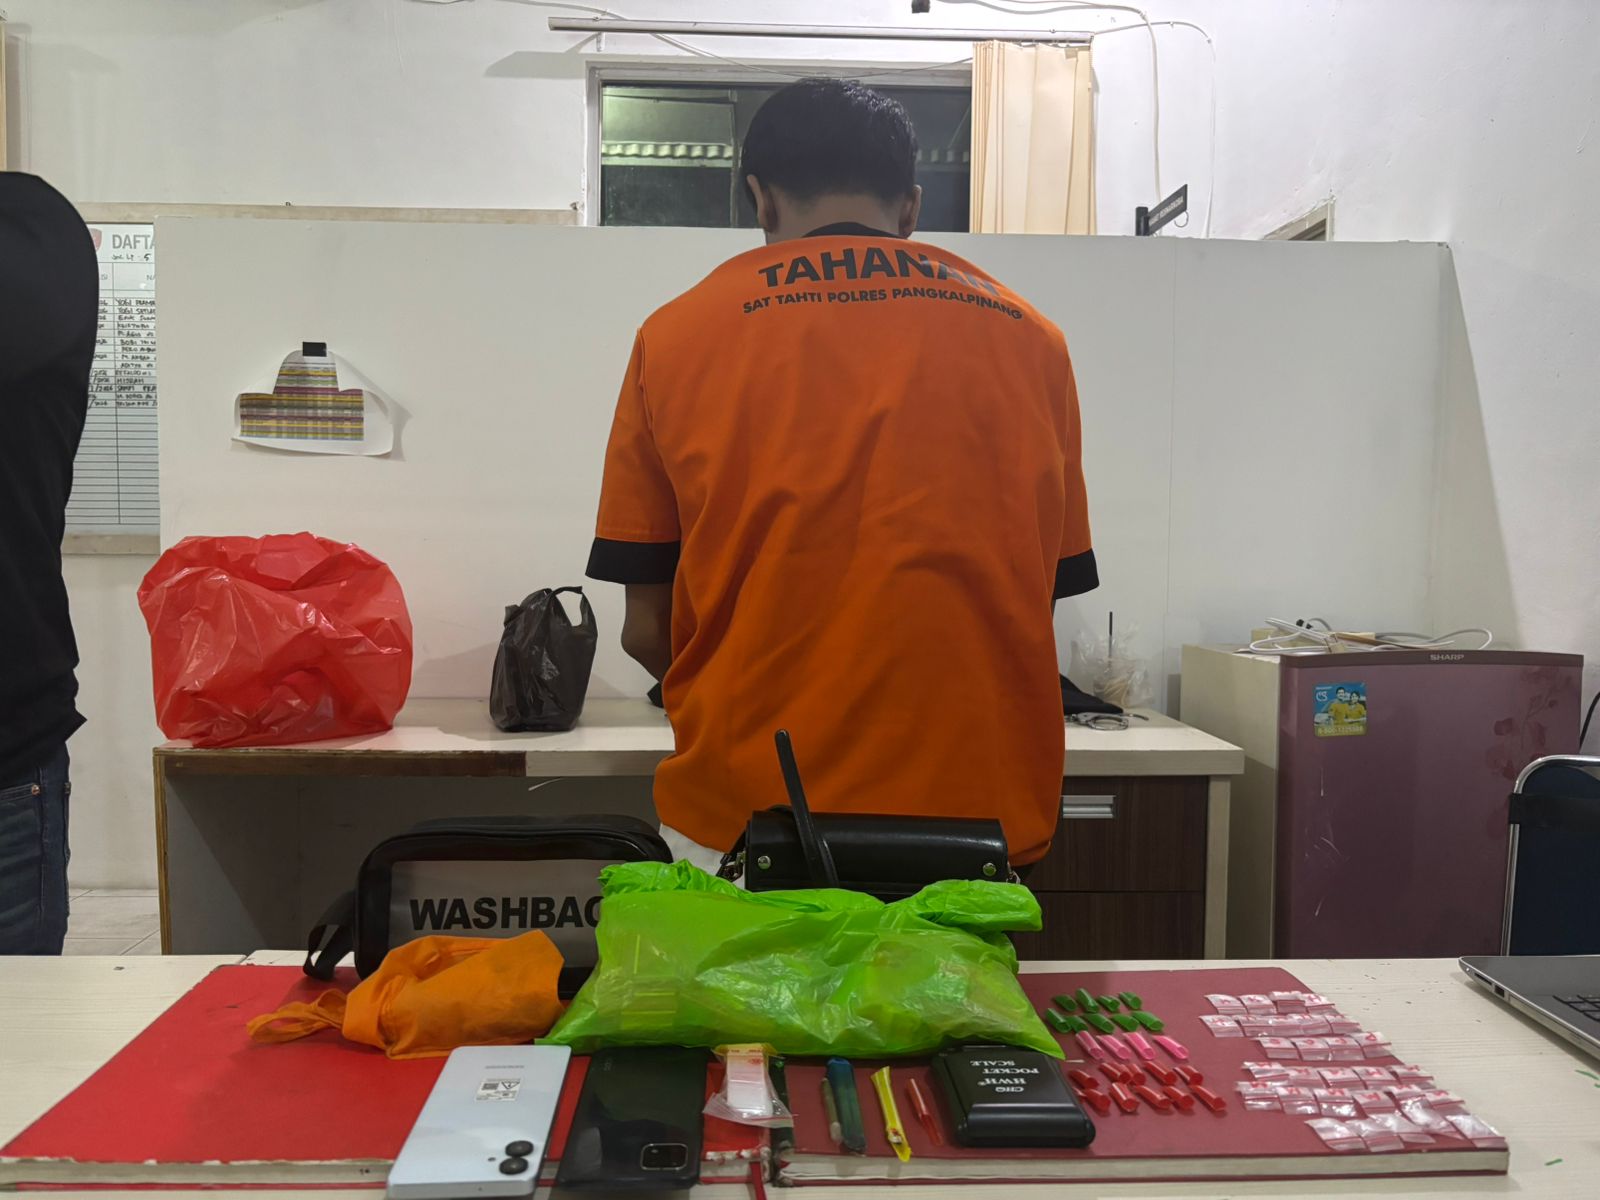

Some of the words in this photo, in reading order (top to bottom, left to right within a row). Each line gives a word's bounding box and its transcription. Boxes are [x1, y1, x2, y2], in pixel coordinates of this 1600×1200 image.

[758, 246, 1001, 297] TAHANAN
[743, 297, 771, 314] SAT
[775, 292, 822, 306] TAHTI
[827, 289, 887, 303] POLRES
[892, 286, 1023, 320] PANGKALPINANG
